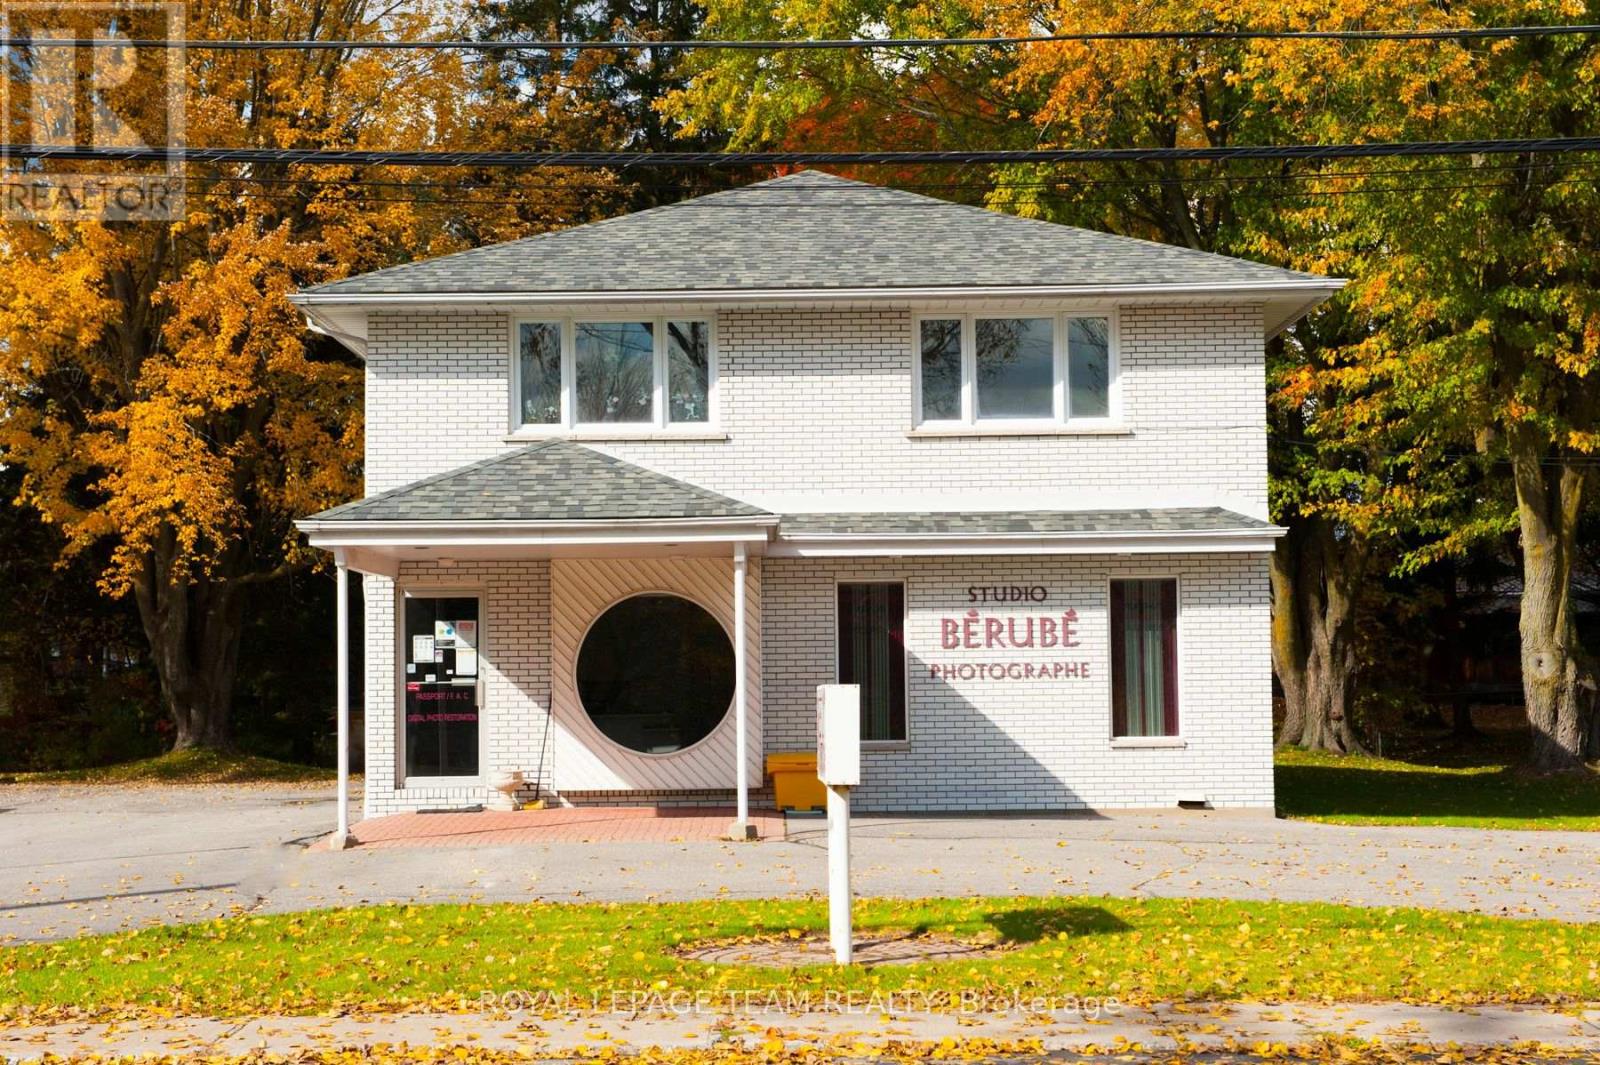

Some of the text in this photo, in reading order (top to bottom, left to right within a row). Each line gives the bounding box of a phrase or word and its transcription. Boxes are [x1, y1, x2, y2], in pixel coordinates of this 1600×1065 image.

[968, 586, 1048, 602] STUDIO
[941, 608, 1081, 649] BÉRUBÉ
[930, 662, 1091, 680] PHOTOGRAPHE
